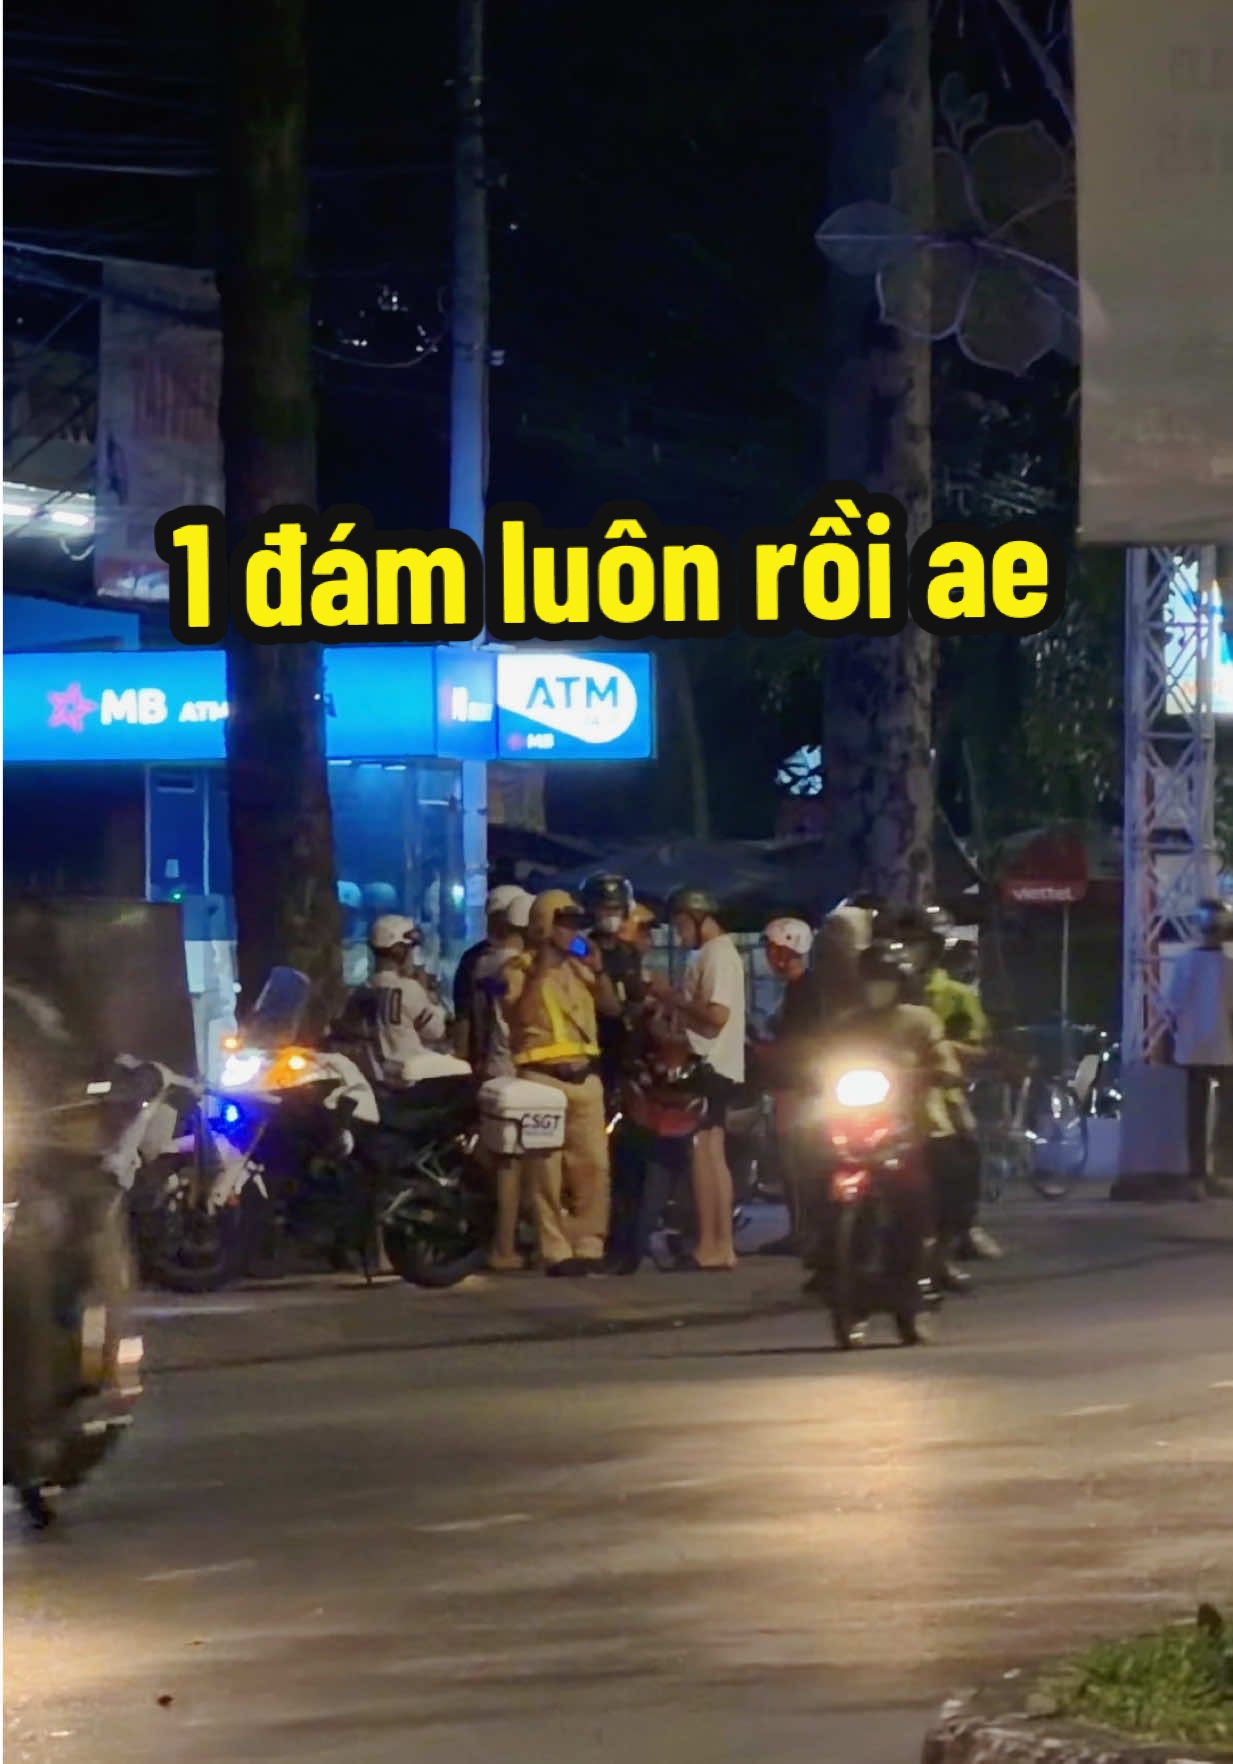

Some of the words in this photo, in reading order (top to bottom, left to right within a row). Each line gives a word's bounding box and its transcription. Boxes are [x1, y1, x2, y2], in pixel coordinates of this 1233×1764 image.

[100, 688, 168, 725] MB
[526, 676, 619, 709] ATM
[520, 1113, 561, 1129] CSGT
